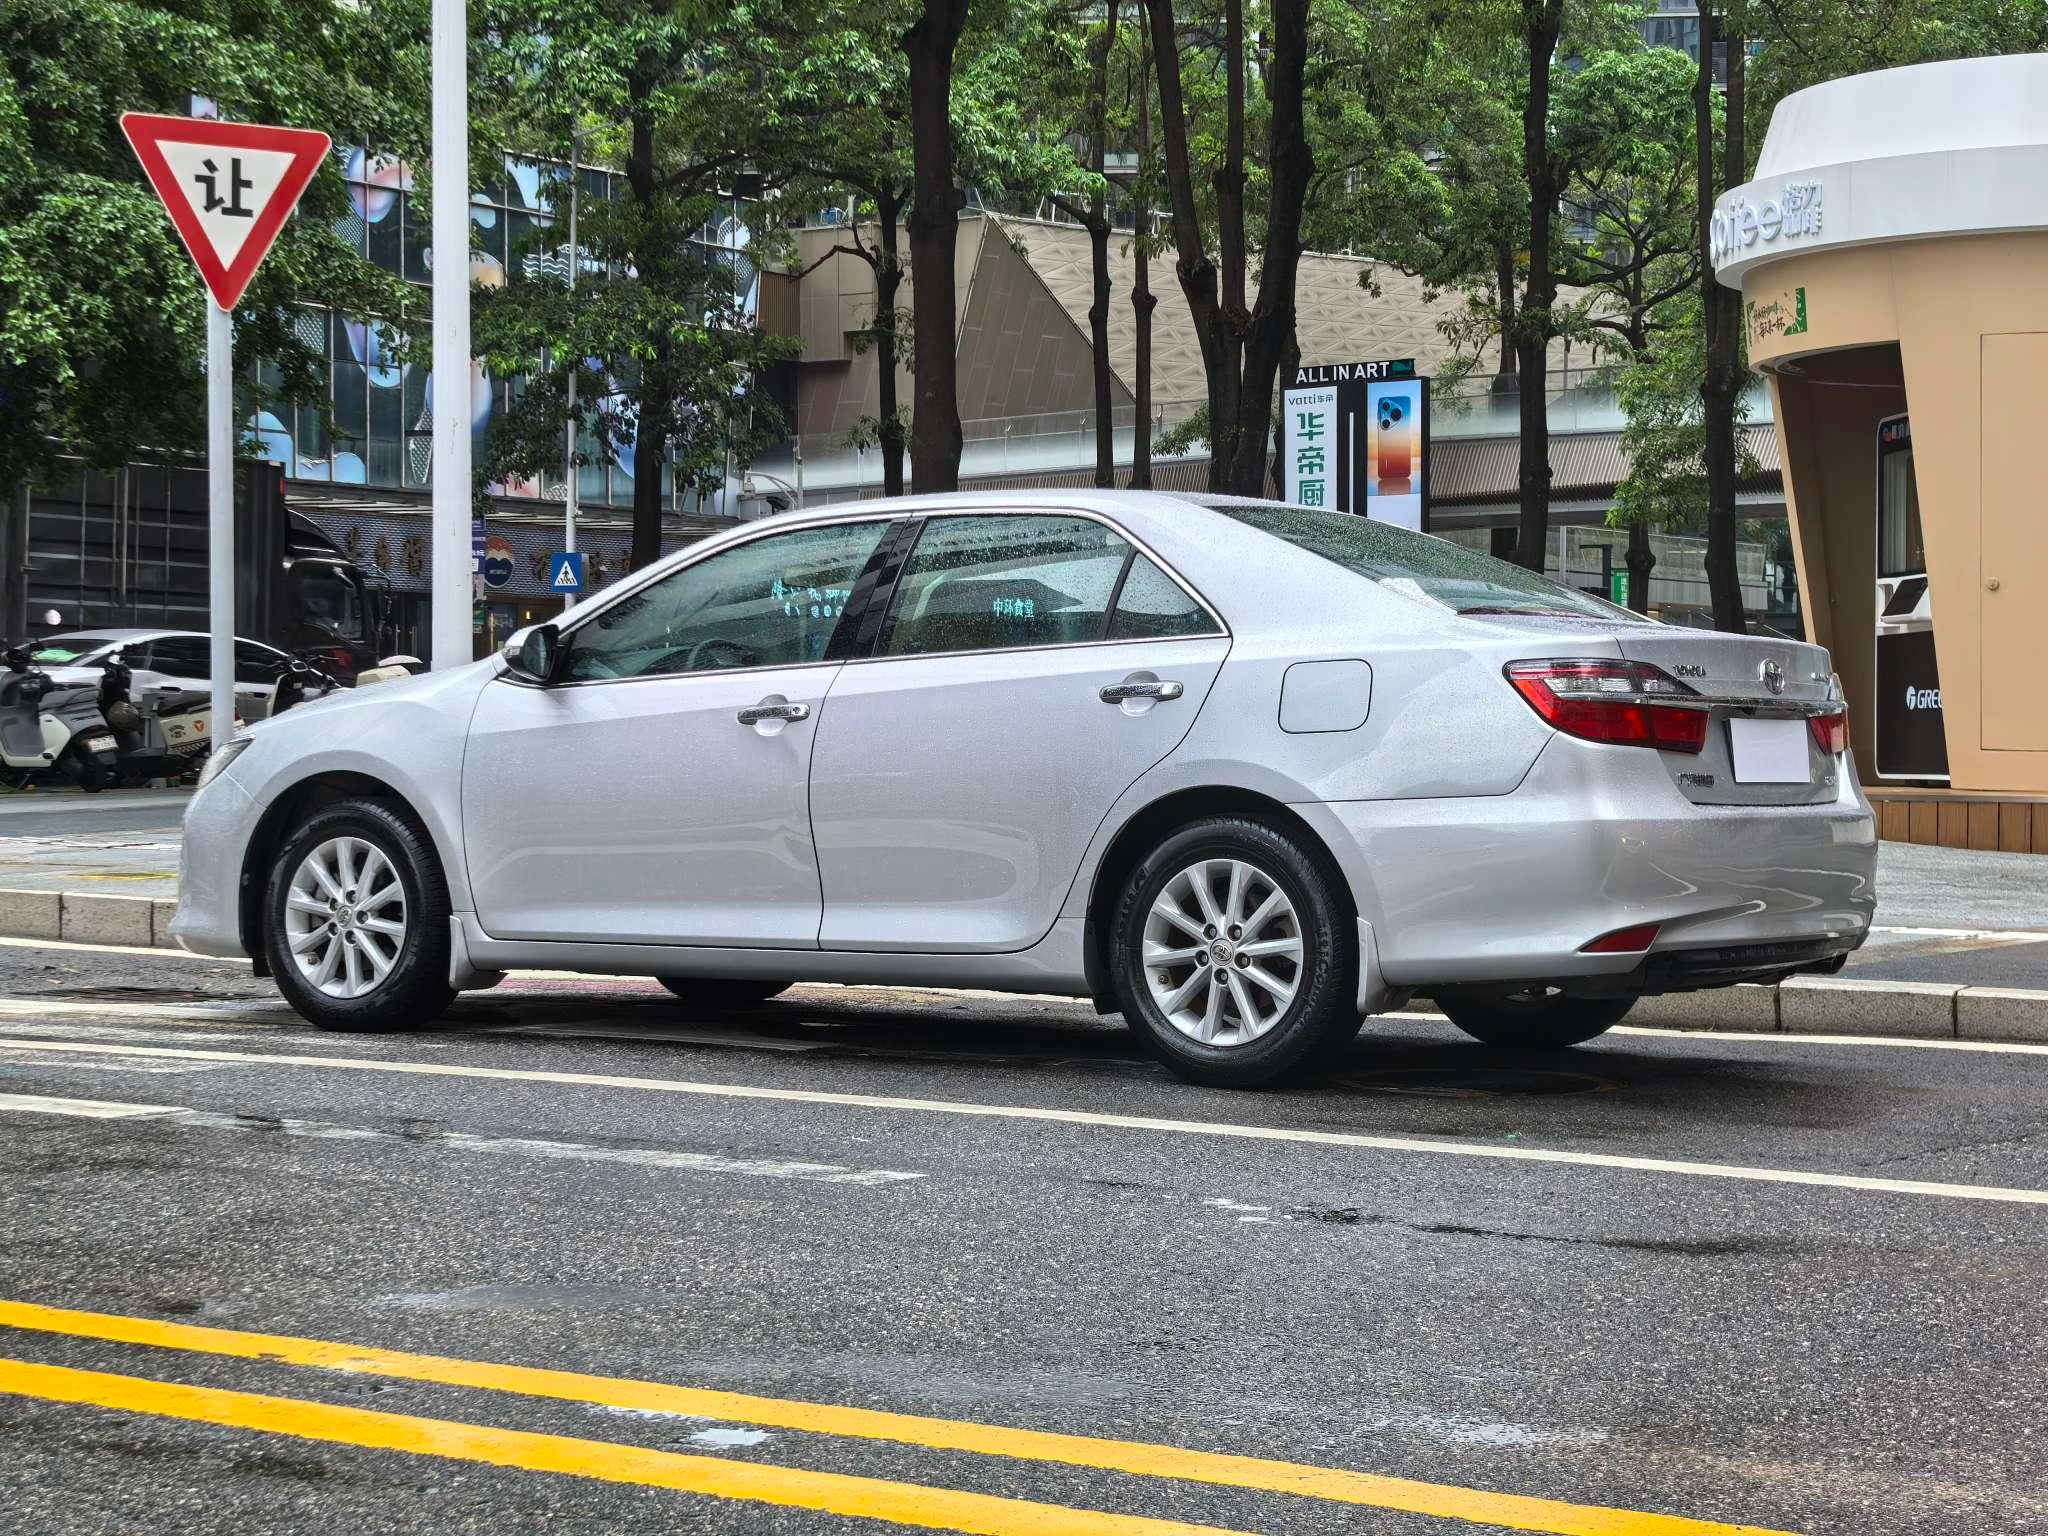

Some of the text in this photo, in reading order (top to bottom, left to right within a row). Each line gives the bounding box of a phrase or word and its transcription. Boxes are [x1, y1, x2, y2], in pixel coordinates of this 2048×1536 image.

[194, 157, 254, 218] 让
[1296, 361, 1390, 384] ALL IN ART
